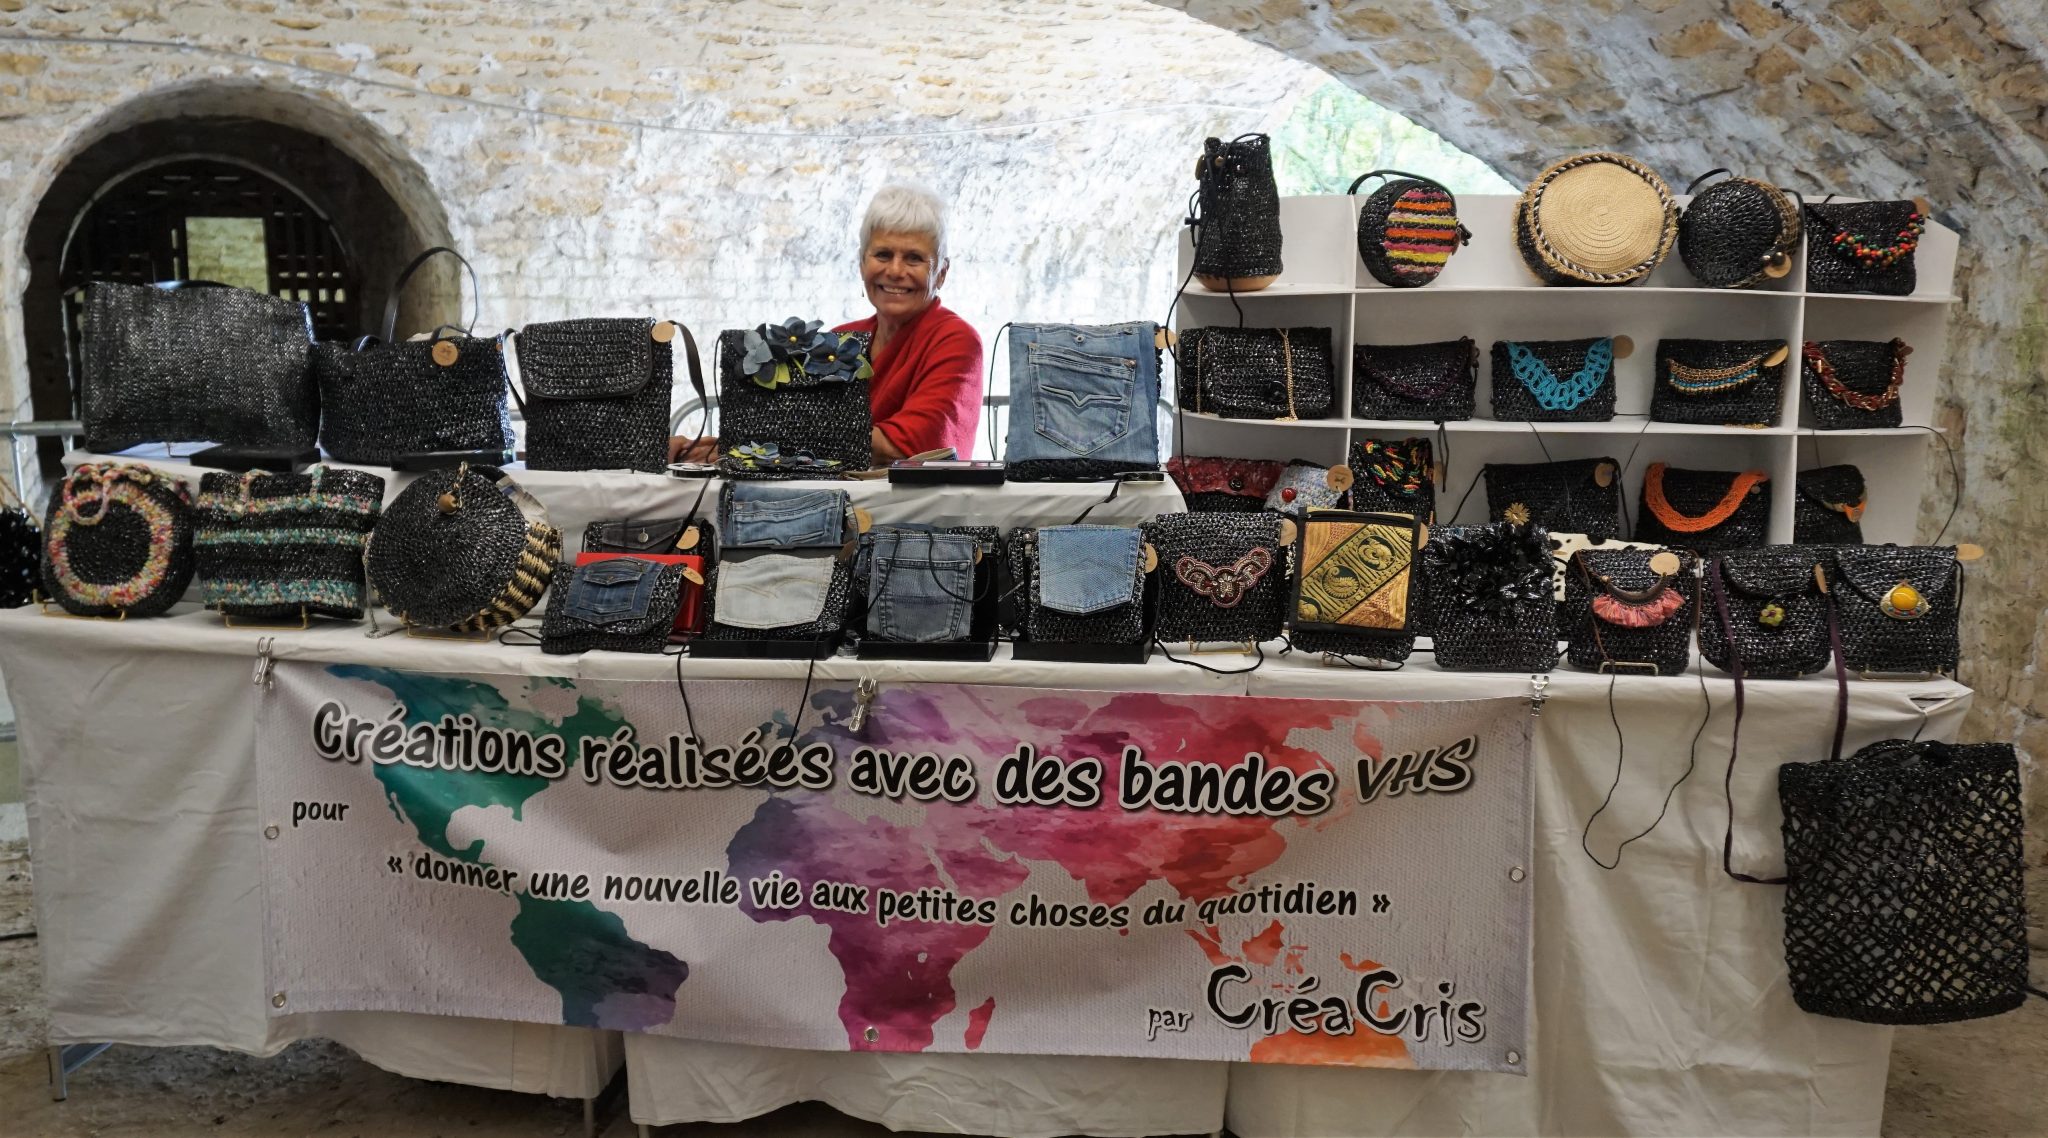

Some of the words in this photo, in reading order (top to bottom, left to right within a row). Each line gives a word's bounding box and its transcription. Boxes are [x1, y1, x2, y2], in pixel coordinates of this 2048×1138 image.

[313, 701, 563, 775] Créations
[583, 729, 830, 785] réalisées
[850, 749, 972, 798] avec
[996, 746, 1099, 802] des
[1122, 749, 1328, 812] bandes
[1356, 737, 1475, 800] VHS
[292, 799, 350, 827] pour
[387, 856, 403, 873] «
[415, 853, 517, 891] donner
[530, 872, 590, 898] une
[604, 870, 738, 904] nouvelle
[752, 873, 800, 906] vie
[812, 882, 867, 911] aux
[879, 889, 996, 924] petites
[1010, 894, 1130, 927] choses
[1143, 899, 1186, 925] du
[1198, 882, 1356, 924] quotidien
[1372, 894, 1391, 913] »
[1148, 1008, 1191, 1039] par
[1207, 965, 1484, 1042] CréaCris
